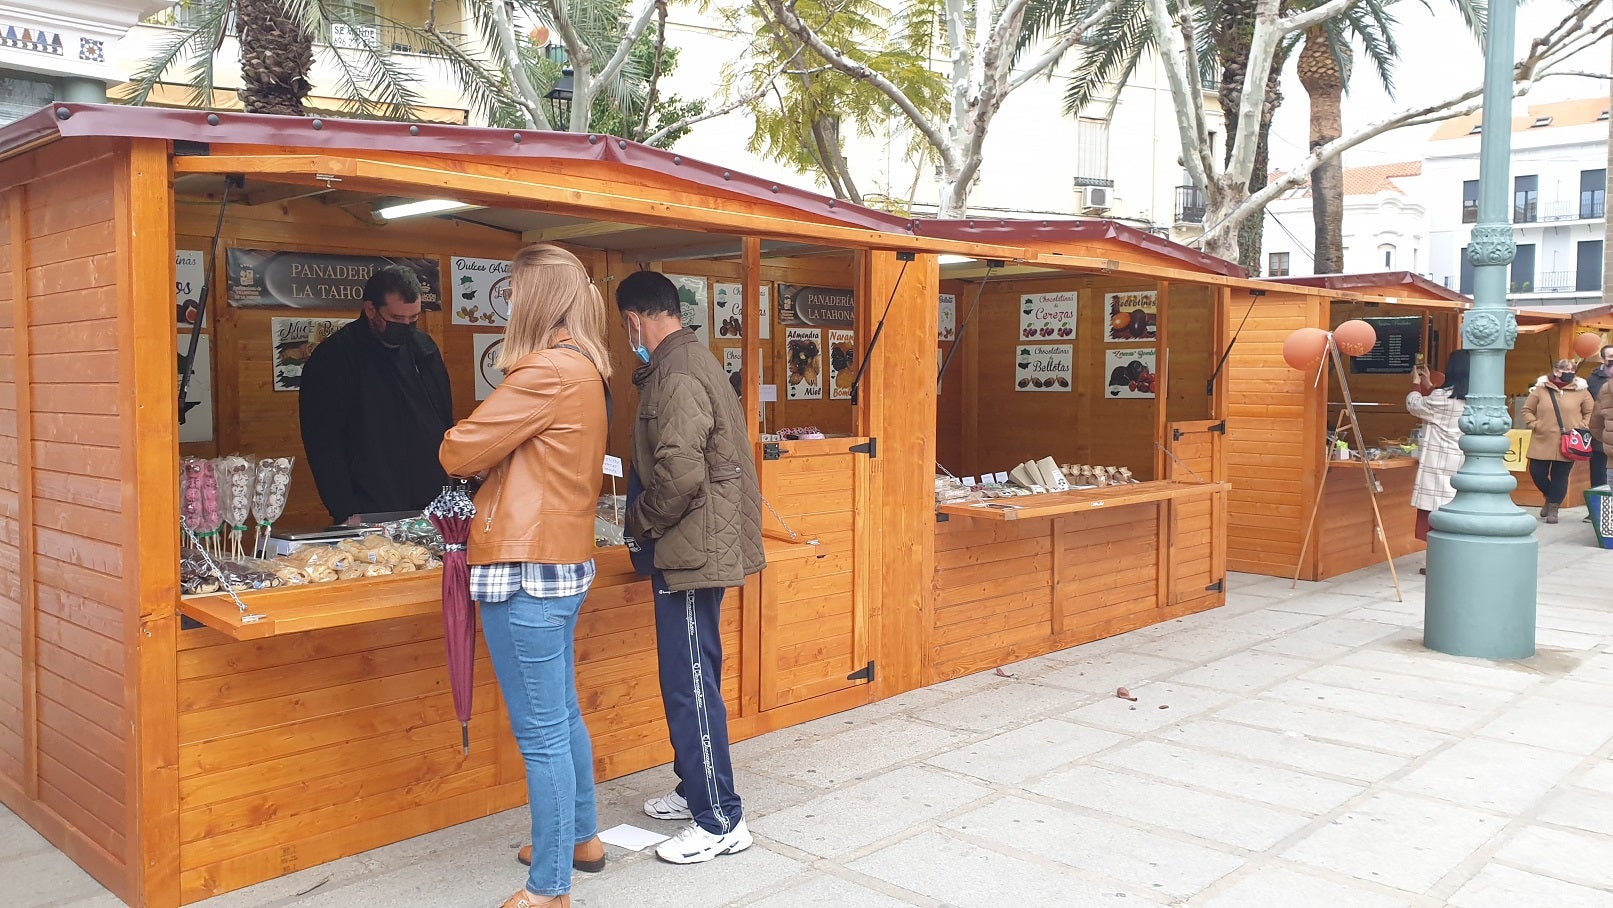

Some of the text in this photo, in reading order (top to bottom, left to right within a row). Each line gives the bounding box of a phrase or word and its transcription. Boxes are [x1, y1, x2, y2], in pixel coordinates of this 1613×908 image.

[291, 263, 376, 281] PANADERÍ
[456, 258, 511, 274] Dulces Art
[292, 284, 365, 301] LA TAHO
[808, 308, 819, 319] LA
[1035, 307, 1074, 323] Cerezas
[787, 330, 819, 340] Almendra
[830, 331, 854, 341] Naran
[1032, 360, 1070, 373] Bellotas
[804, 387, 821, 396] Miel
[1503, 437, 1522, 462] el
